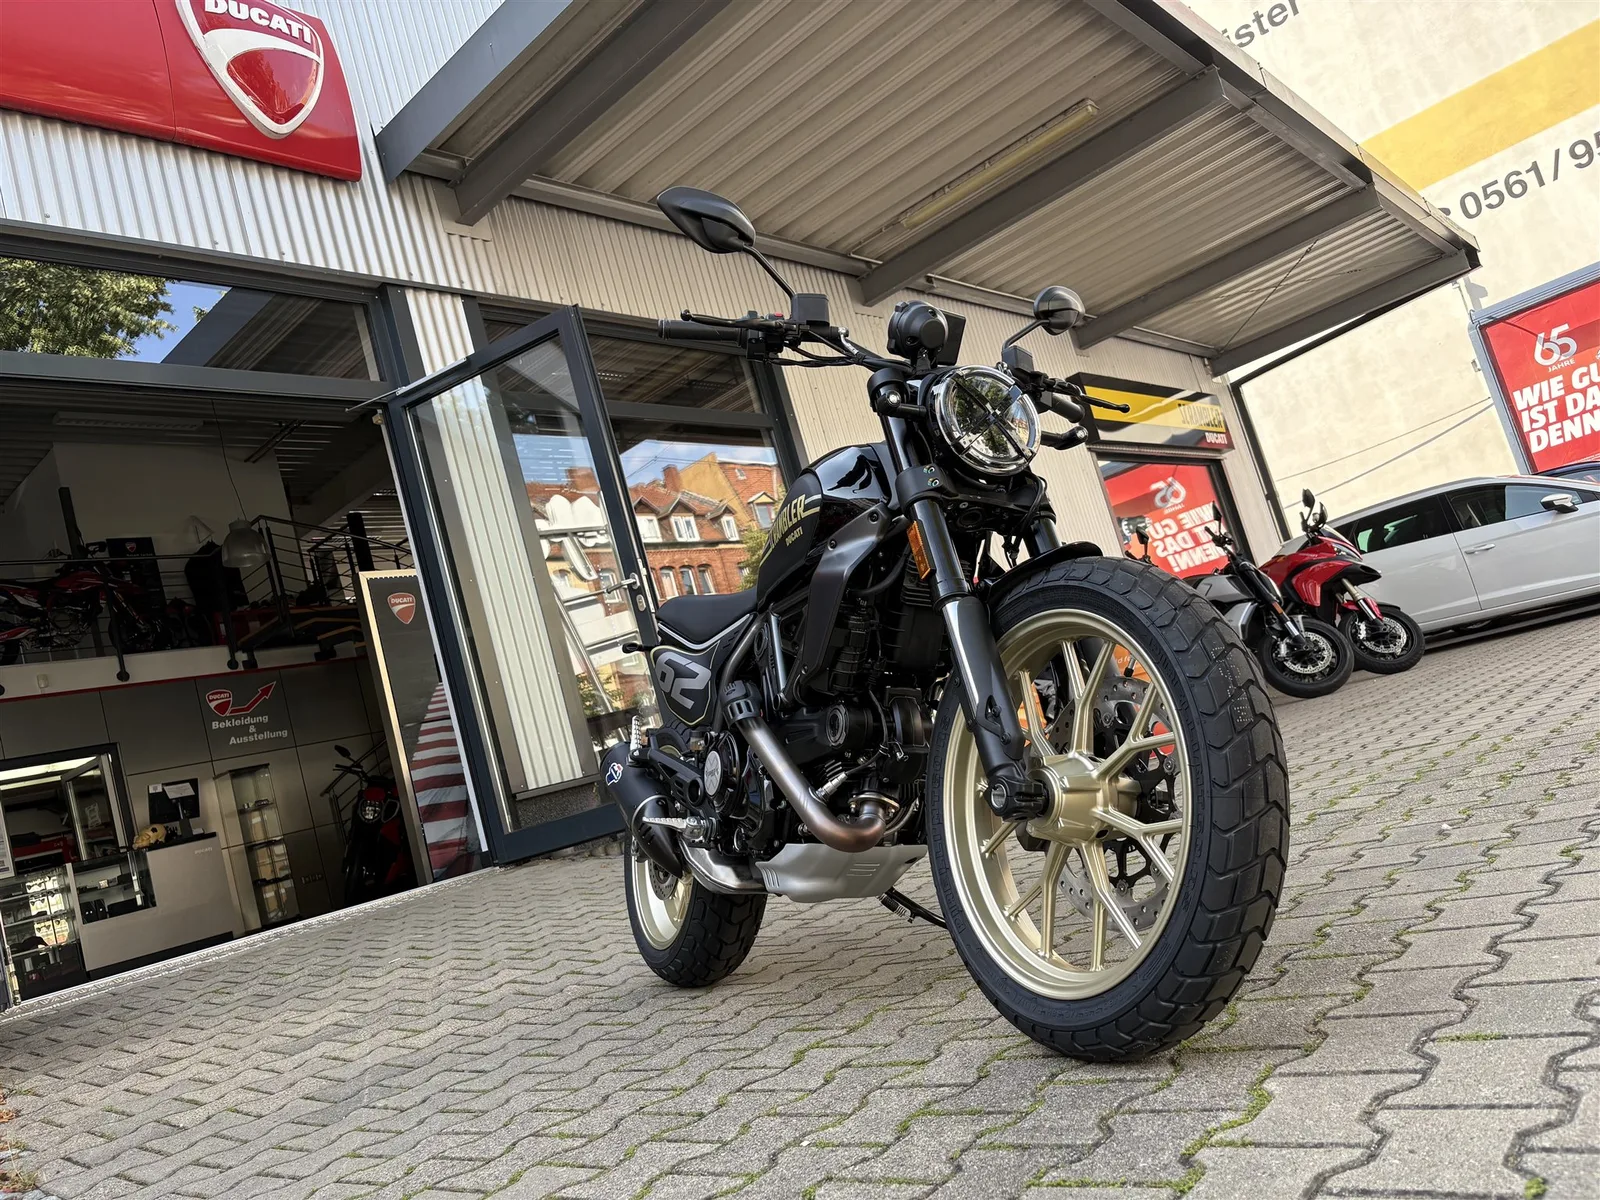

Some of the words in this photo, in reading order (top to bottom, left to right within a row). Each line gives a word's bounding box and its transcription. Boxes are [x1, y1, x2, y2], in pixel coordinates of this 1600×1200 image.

[205, 0, 312, 45] DUCATI
[1534, 323, 1577, 366] 65
[1547, 358, 1576, 373] JAHRE
[1512, 374, 1565, 412] WIE
[1521, 399, 1559, 433] IST
[1204, 431, 1228, 445] DUCATI
[1529, 408, 1600, 454] DENN
[785, 526, 803, 546] DUCATI
[655, 651, 712, 710] 62
[208, 692, 230, 701] DUCATI
[211, 714, 269, 730] Bekleidung
[248, 724, 257, 733] &
[229, 729, 288, 746] Ausstellung
